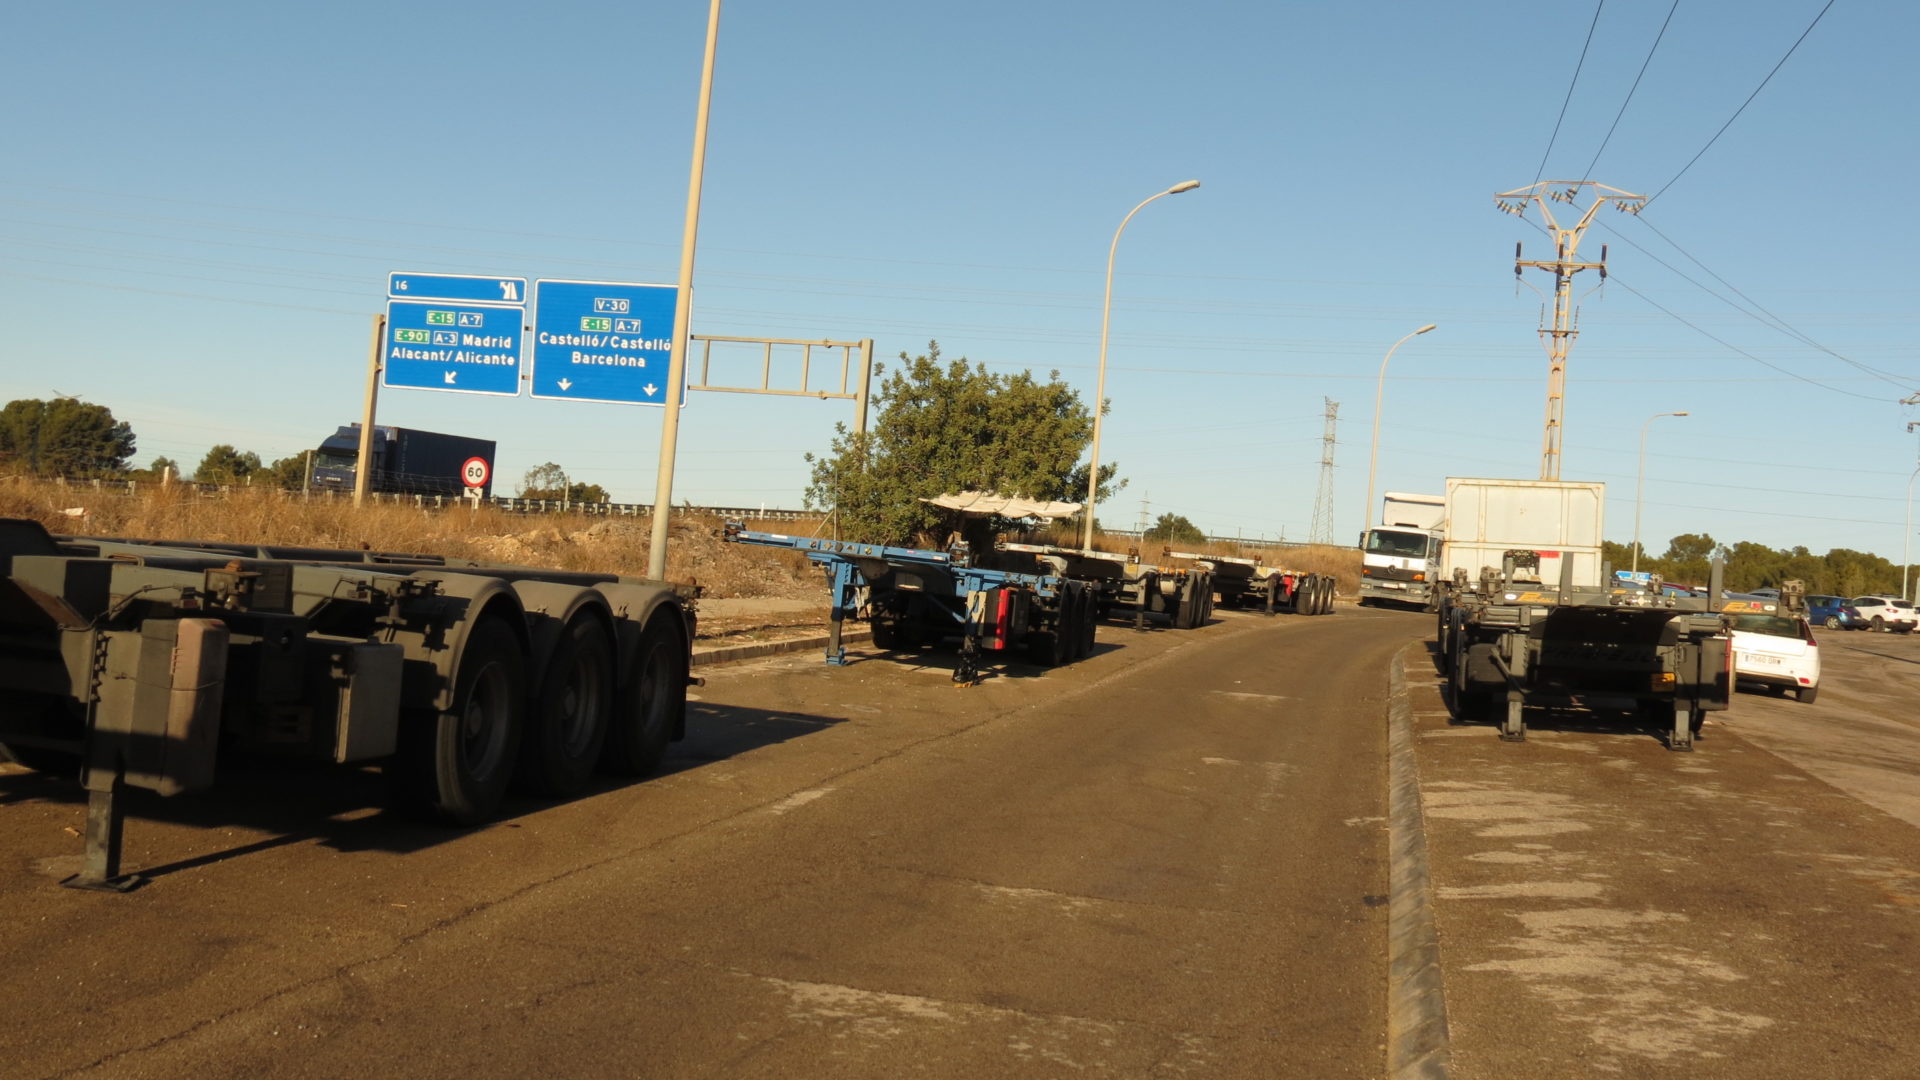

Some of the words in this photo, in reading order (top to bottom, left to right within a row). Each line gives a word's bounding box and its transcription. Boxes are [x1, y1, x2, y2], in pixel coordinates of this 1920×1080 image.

[395, 280, 408, 290] 16
[597, 300, 628, 312] V-30
[428, 313, 454, 324] E-15
[460, 314, 481, 325] A-7
[582, 318, 610, 330] E-15
[617, 321, 639, 332] A-7
[396, 330, 429, 342] E-901
[434, 333, 456, 344] A-3
[463, 334, 512, 349] Madrid
[571, 351, 646, 368] Barcelona
[467, 466, 483, 478] 60
